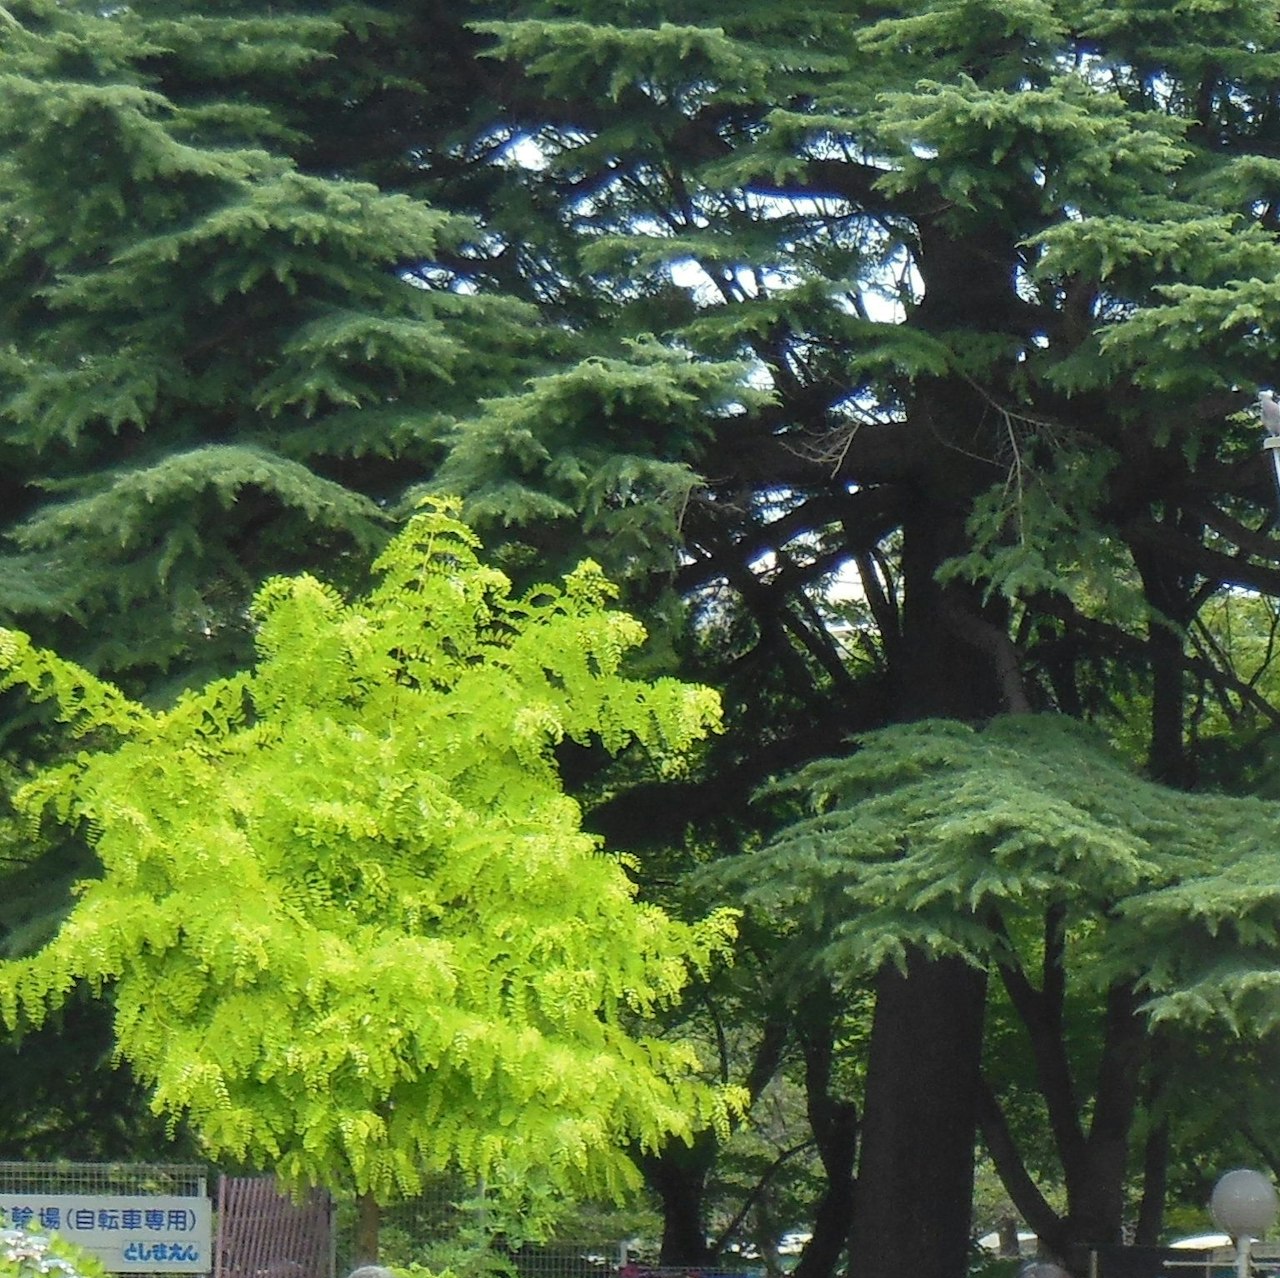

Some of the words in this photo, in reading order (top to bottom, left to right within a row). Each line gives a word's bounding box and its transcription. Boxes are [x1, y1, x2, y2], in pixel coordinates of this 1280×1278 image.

[0, 1206, 196, 1232] 輪場(自転車専用)
[124, 1243, 199, 1261] としまえん
